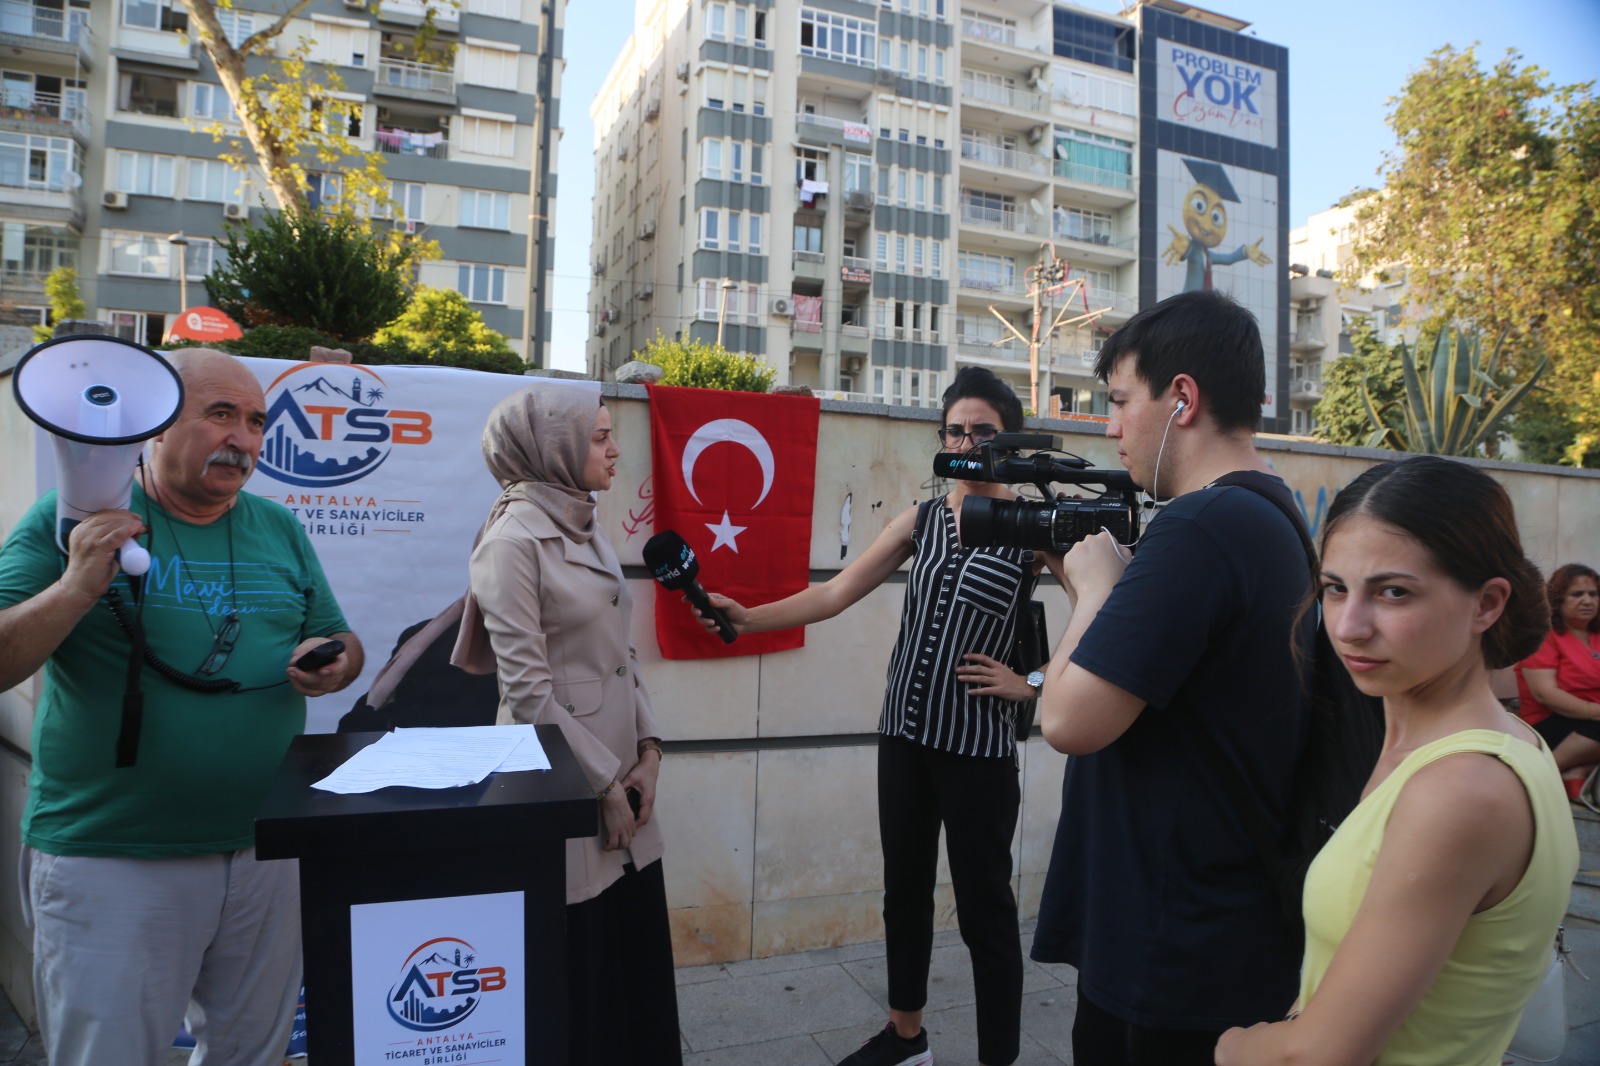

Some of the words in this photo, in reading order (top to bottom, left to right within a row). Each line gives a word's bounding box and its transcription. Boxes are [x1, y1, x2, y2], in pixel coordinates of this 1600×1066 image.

[1172, 47, 1262, 86] PROBLEM
[1176, 64, 1259, 115] YOK
[263, 388, 433, 445] ATSB
[285, 494, 377, 507] ANTALYA
[306, 508, 325, 520] VE
[329, 509, 425, 523] SANAYİCİLER
[145, 554, 236, 604] Mavi
[392, 963, 507, 1002] ATSB
[385, 1048, 427, 1061] TİCARET
[430, 1046, 446, 1055] VE
[445, 1038, 506, 1053] SANAYİCİLER
[417, 1032, 474, 1047] ANTALYA
[424, 1051, 467, 1066] BİRLİĞİ
